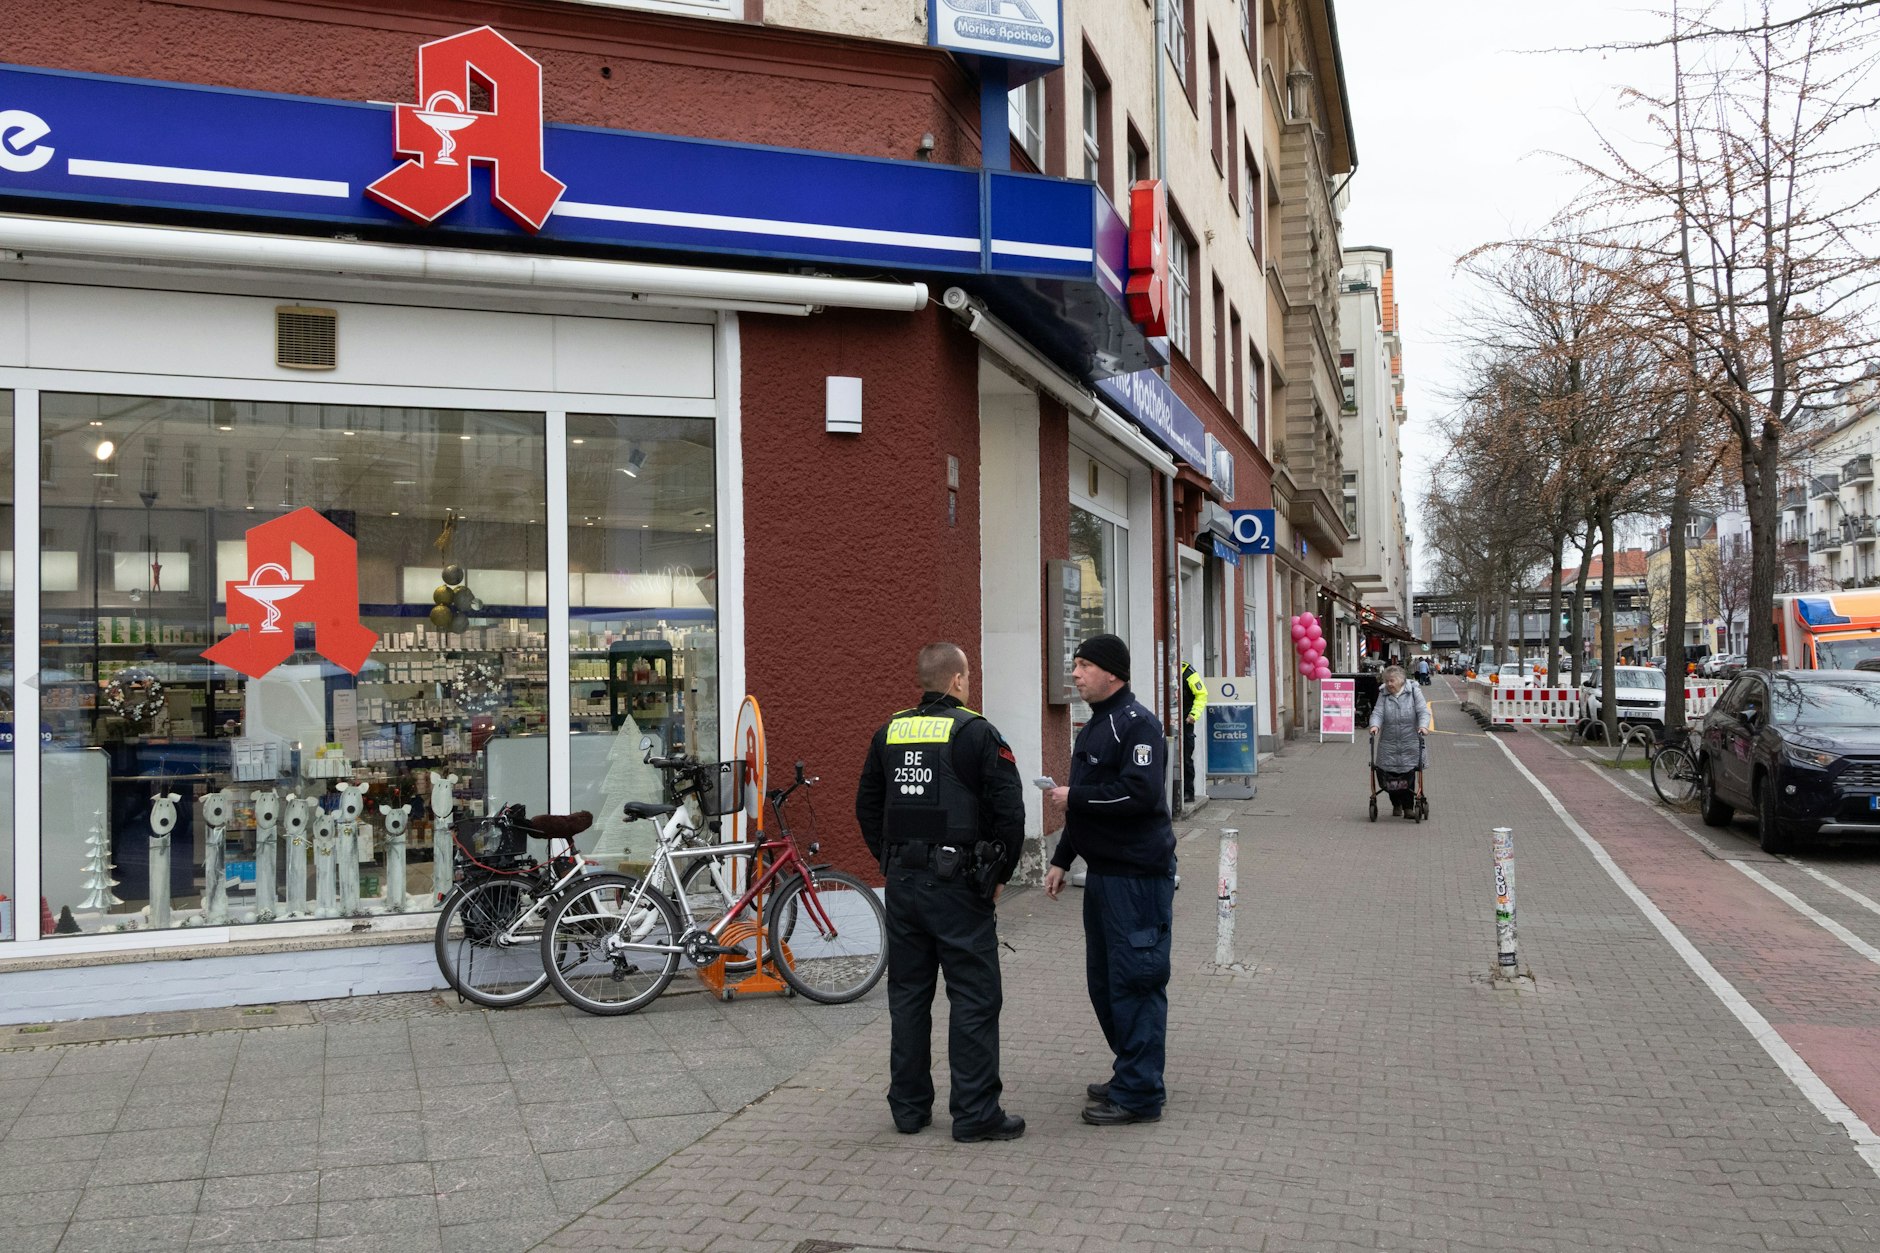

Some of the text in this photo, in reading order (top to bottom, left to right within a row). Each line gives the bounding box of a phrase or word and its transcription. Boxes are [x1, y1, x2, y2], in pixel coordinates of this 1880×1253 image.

[957, 20, 1052, 44] Mörike Apotheke
[1132, 371, 1171, 435] Apotheke
[889, 719, 949, 740] POLIZEI
[1213, 730, 1248, 739] Gratis
[904, 751, 923, 766] BE
[894, 767, 933, 783] 25300
